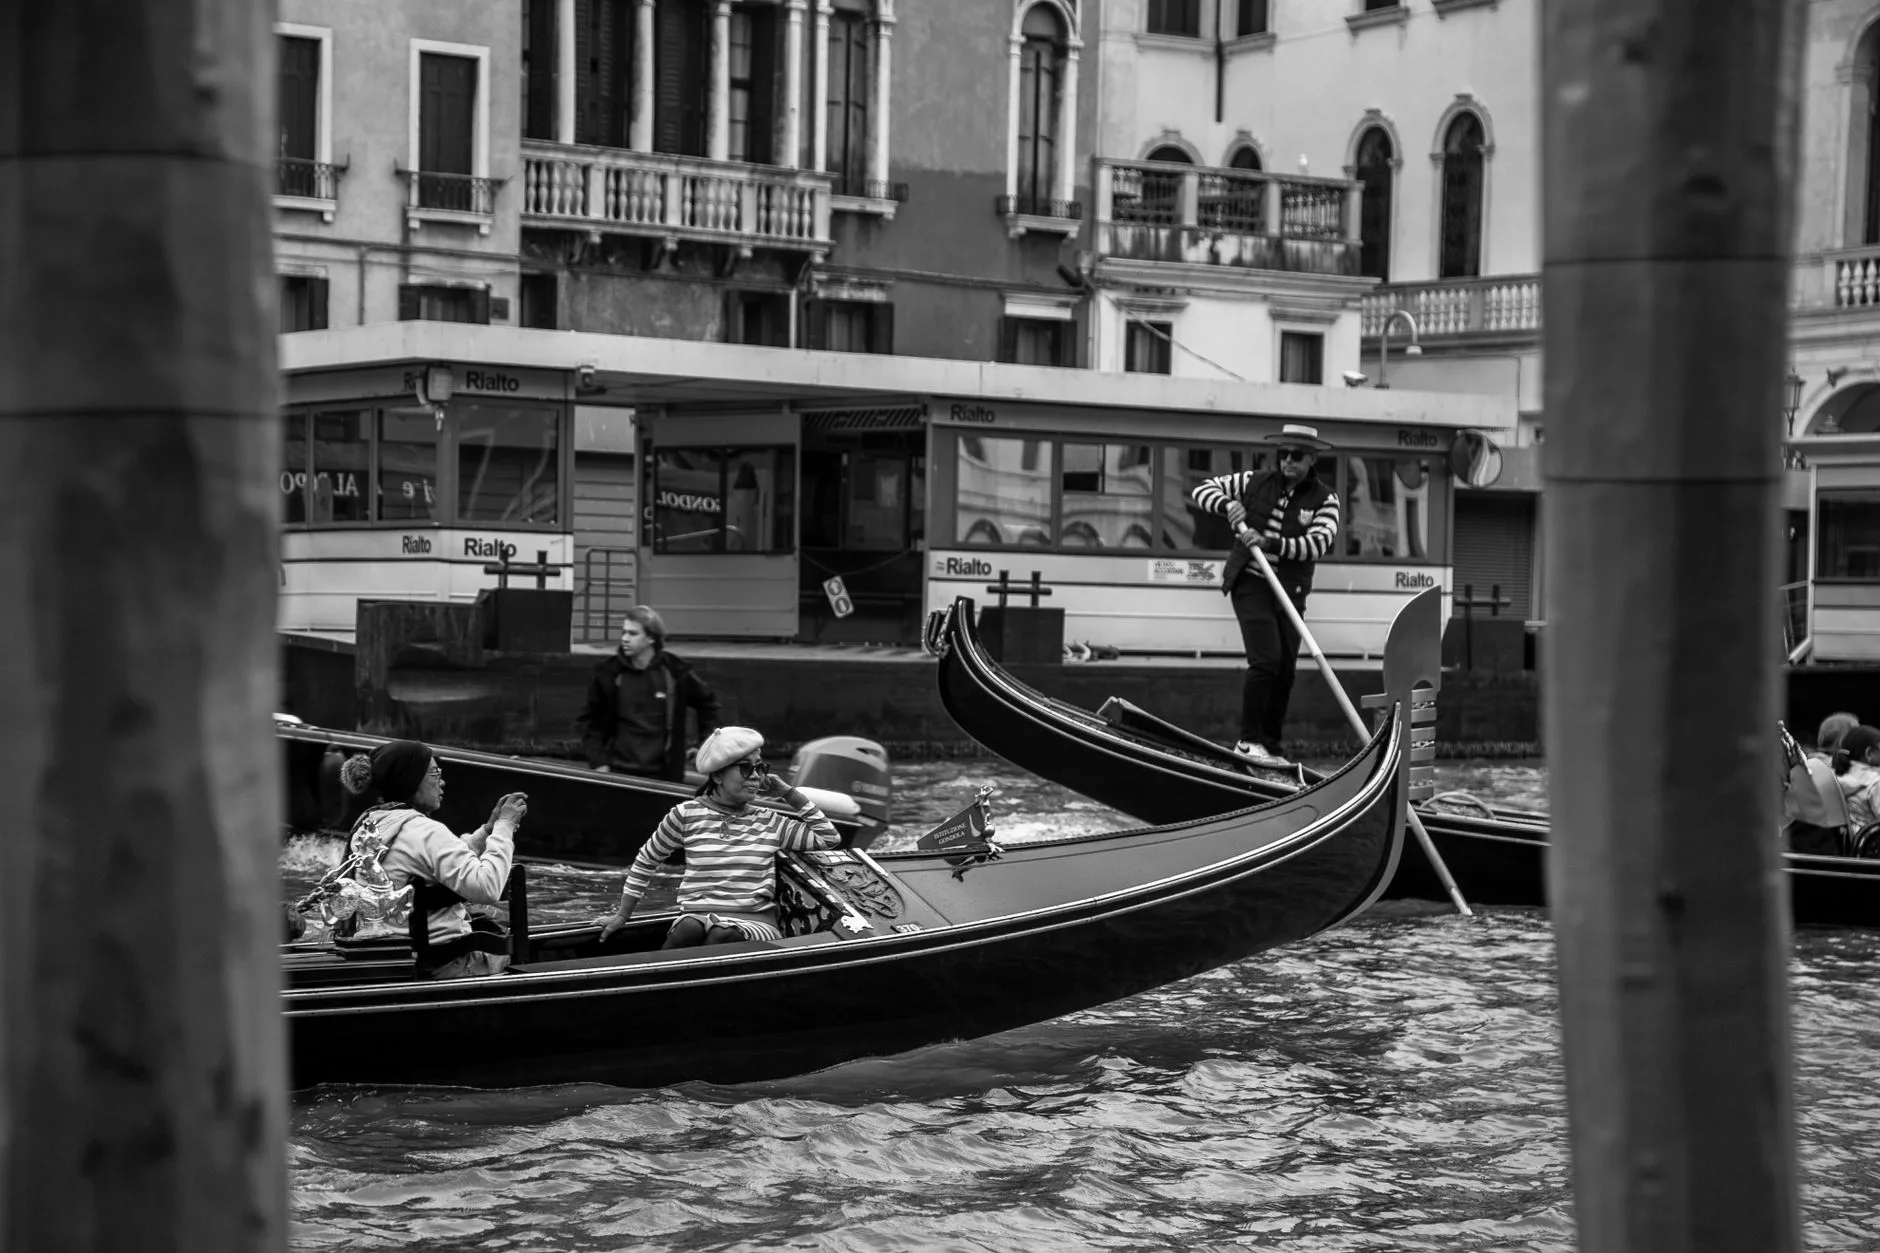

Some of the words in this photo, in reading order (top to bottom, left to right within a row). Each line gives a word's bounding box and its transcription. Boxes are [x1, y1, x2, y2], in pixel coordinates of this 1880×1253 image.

[465, 370, 519, 392] Rialto
[950, 403, 996, 423] Rialto
[1398, 429, 1438, 447] Rialto
[402, 535, 432, 554] Rialto
[464, 537, 517, 557] Rialto
[946, 557, 992, 576] Rialto
[1395, 571, 1434, 588] Rialto
[938, 831, 966, 845] GONDOLA
